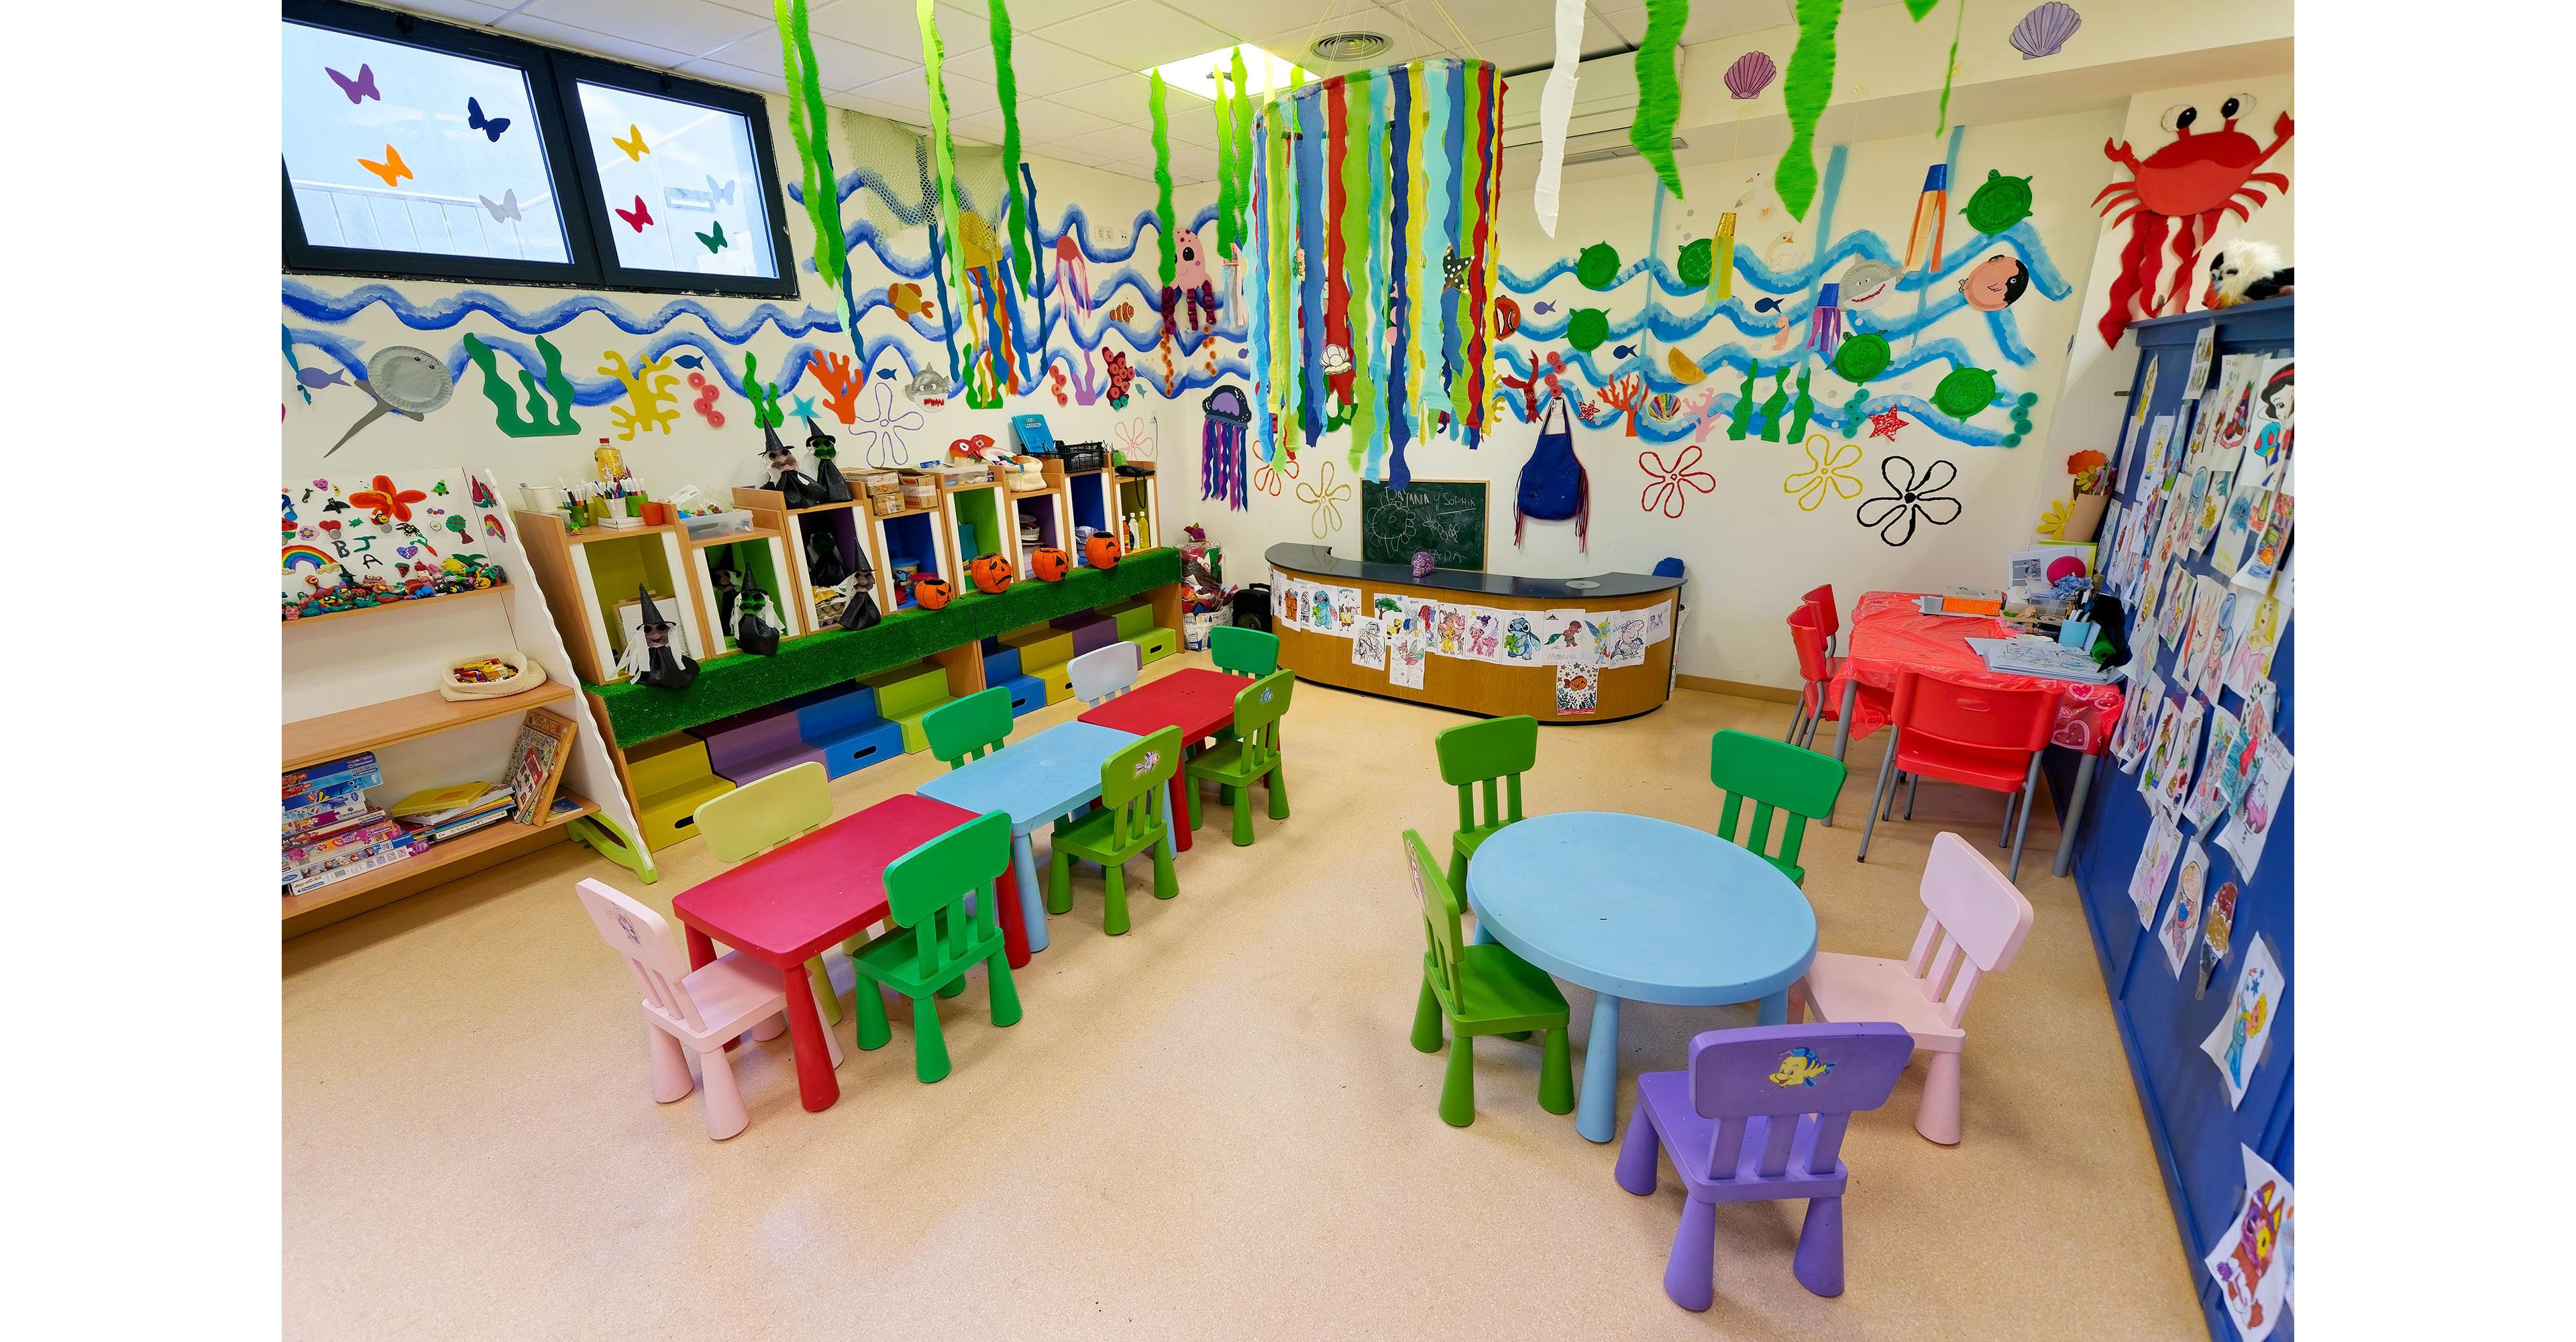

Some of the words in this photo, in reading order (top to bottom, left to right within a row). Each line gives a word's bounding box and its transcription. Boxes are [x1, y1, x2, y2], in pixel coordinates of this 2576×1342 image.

[331, 540, 350, 558] B
[363, 554, 383, 569] A
[338, 808, 366, 818] Clementoni
